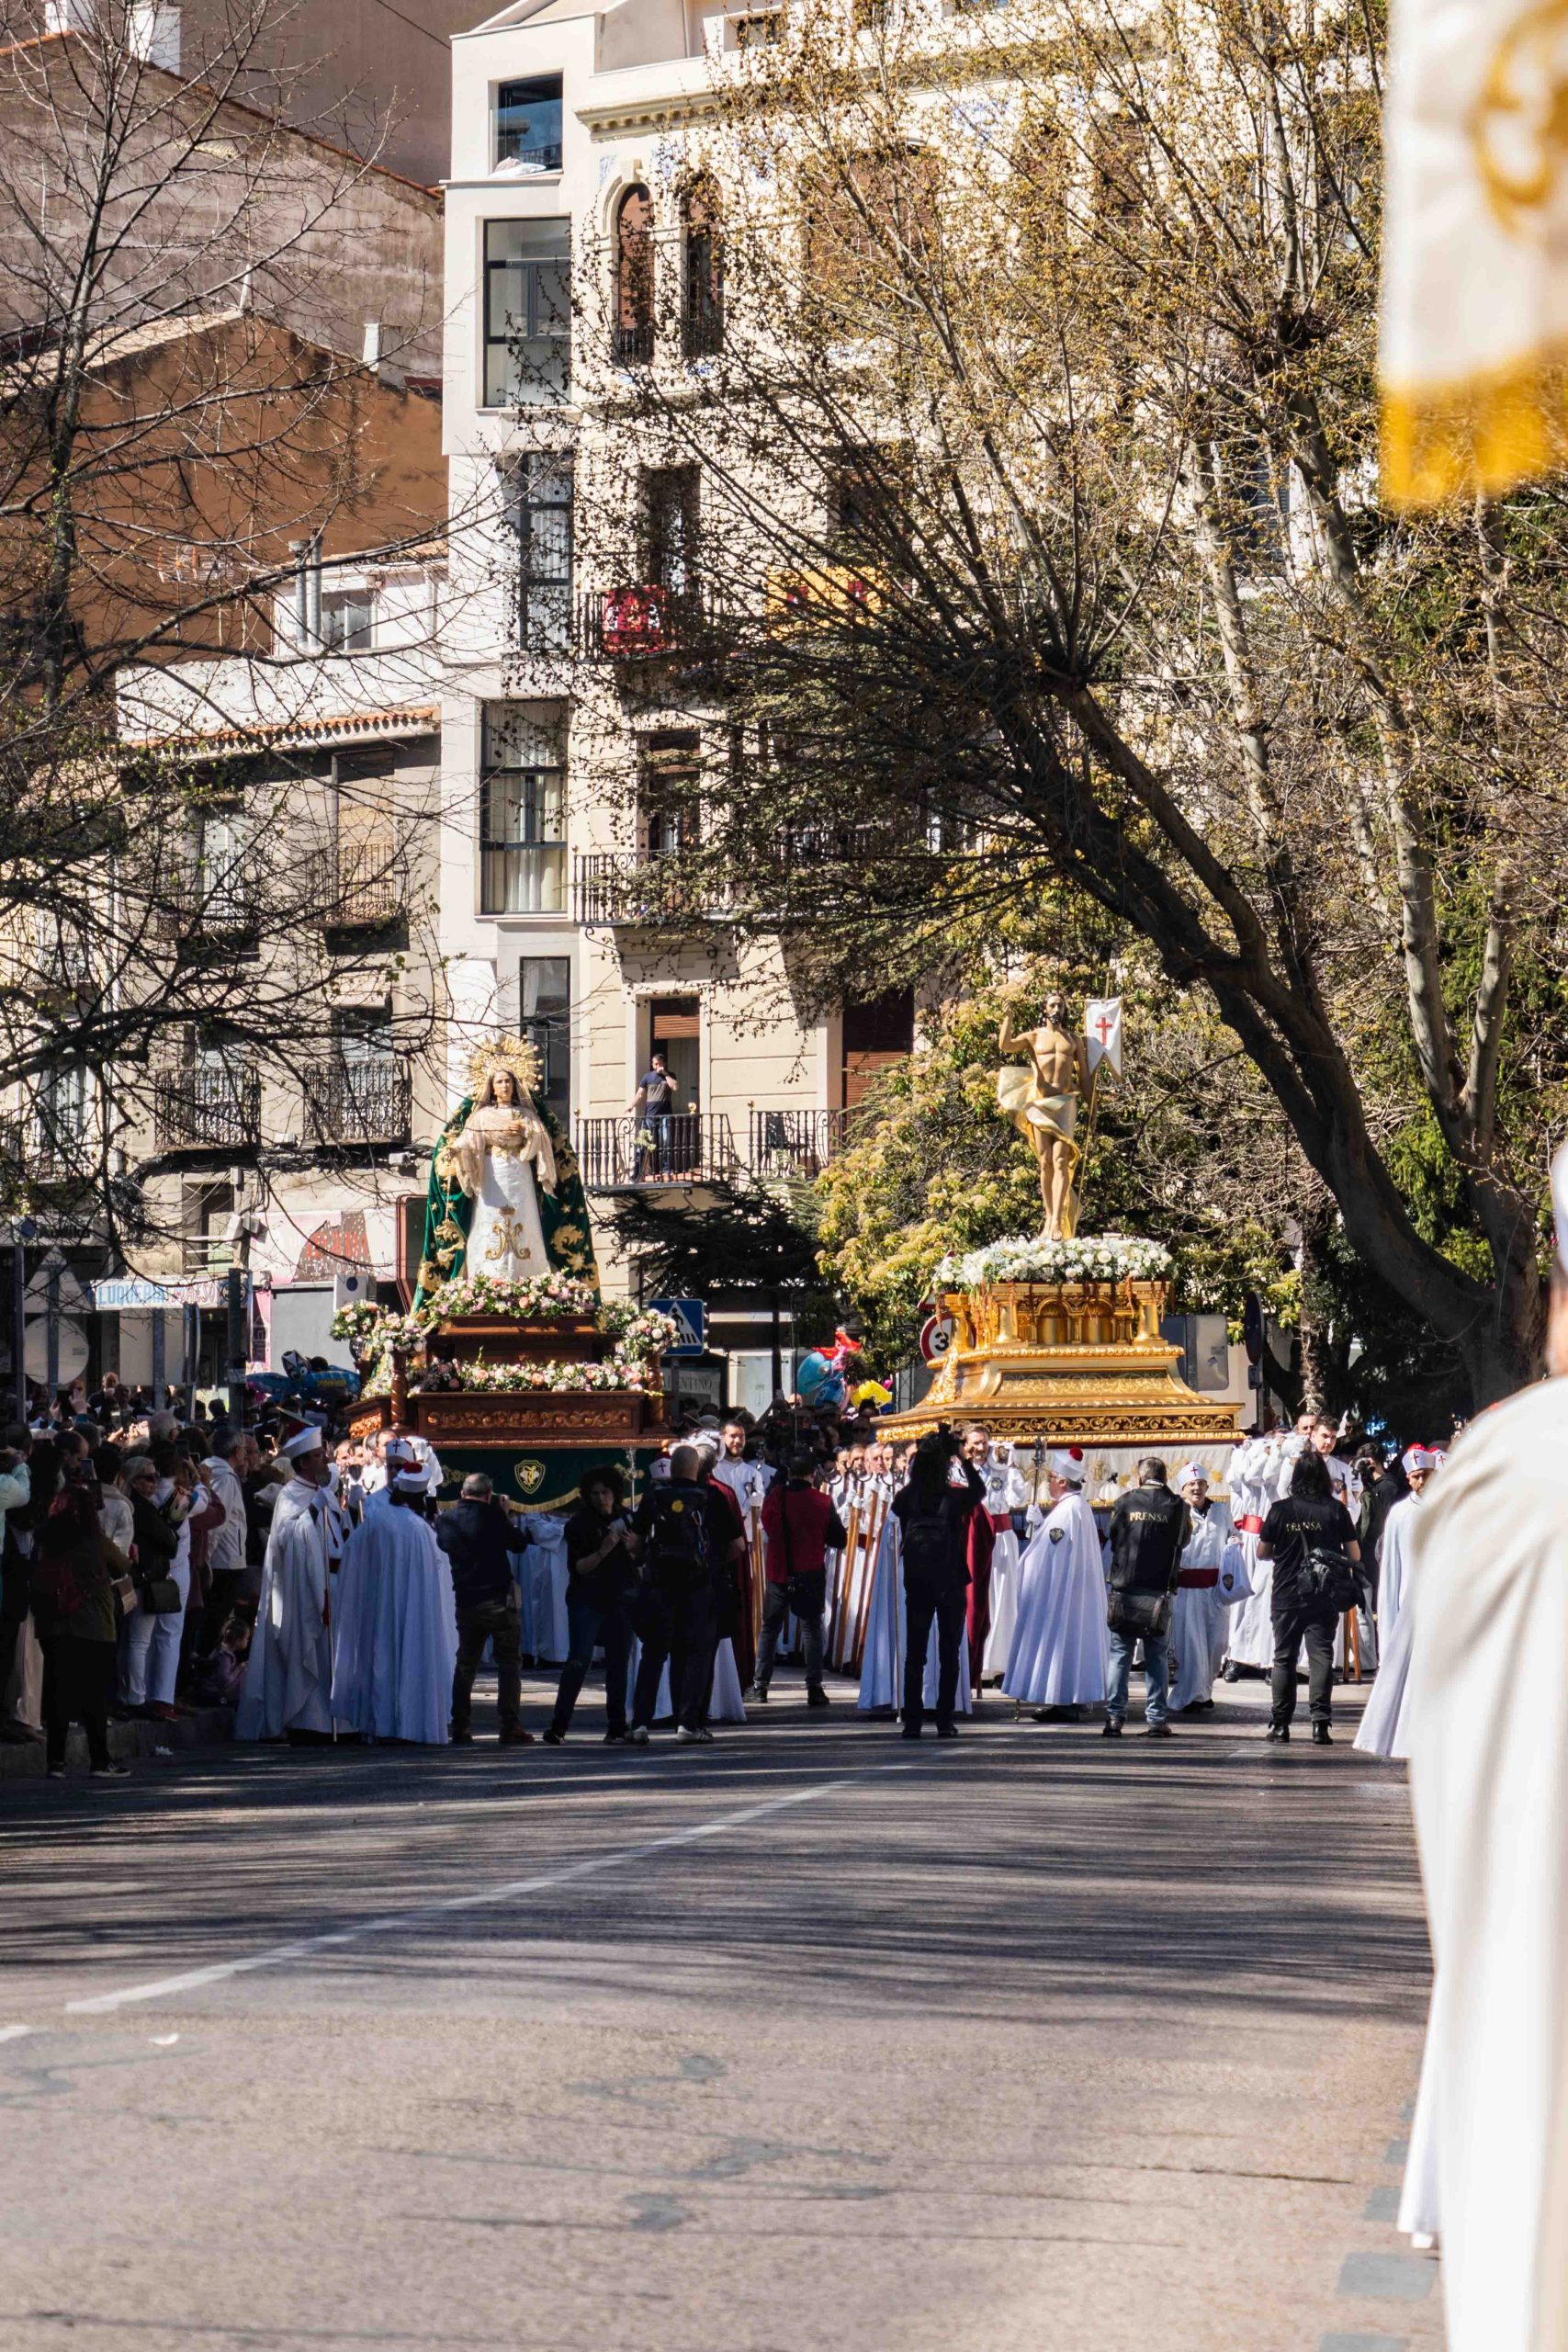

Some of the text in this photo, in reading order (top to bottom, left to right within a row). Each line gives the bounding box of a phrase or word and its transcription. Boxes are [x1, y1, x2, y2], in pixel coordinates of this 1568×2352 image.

[935, 1331, 950, 1351] 3
[1130, 1511, 1168, 1523] PRENSA
[1286, 1521, 1322, 1532] PRENSA
